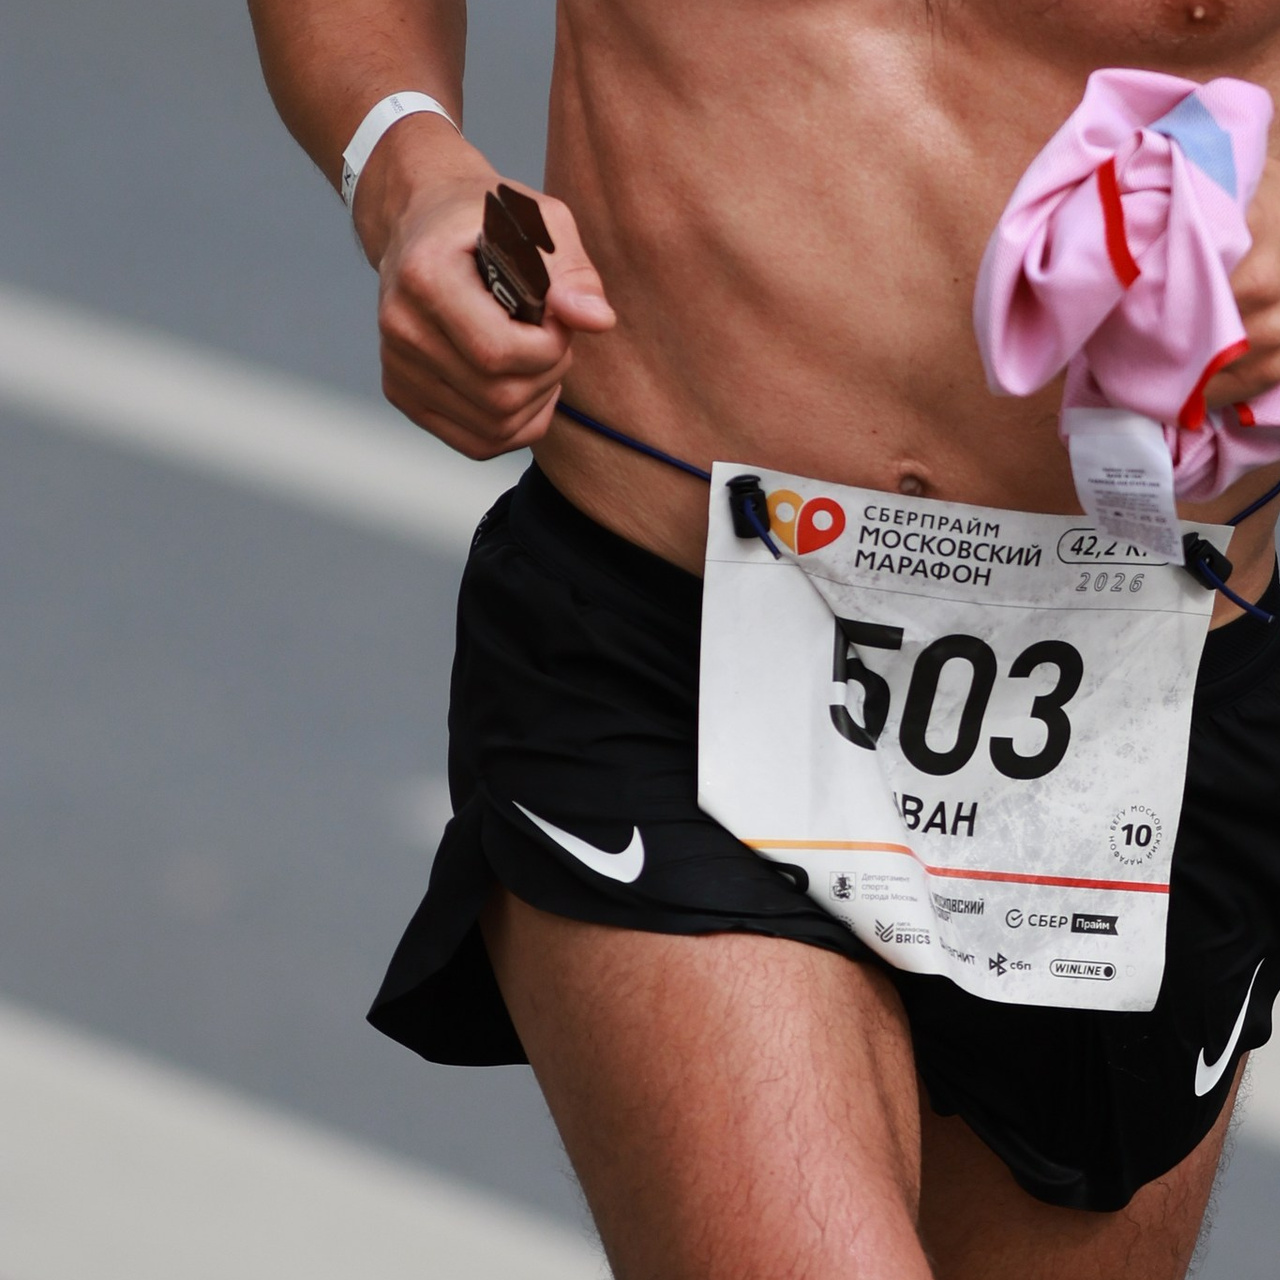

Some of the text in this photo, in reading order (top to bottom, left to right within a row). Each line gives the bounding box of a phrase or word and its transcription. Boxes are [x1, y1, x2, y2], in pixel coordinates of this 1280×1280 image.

[864, 505, 1000, 539] СБЕРПРАЙМ
[859, 525, 1042, 567] МОСКОВСКИЙ
[854, 549, 992, 587] МАРАФОН
[1075, 571, 1145, 593] 2026
[829, 615, 1084, 781] 503
[893, 791, 978, 837] ВАН
[1121, 823, 1152, 847] 10
[1108, 835, 1143, 866] МАРАФОН
[1028, 913, 1110, 931] СБЕР Прайм
[895, 933, 931, 945] BRICS
[1010, 960, 1032, 971] сбп
[1055, 962, 1102, 977] WINLINE
